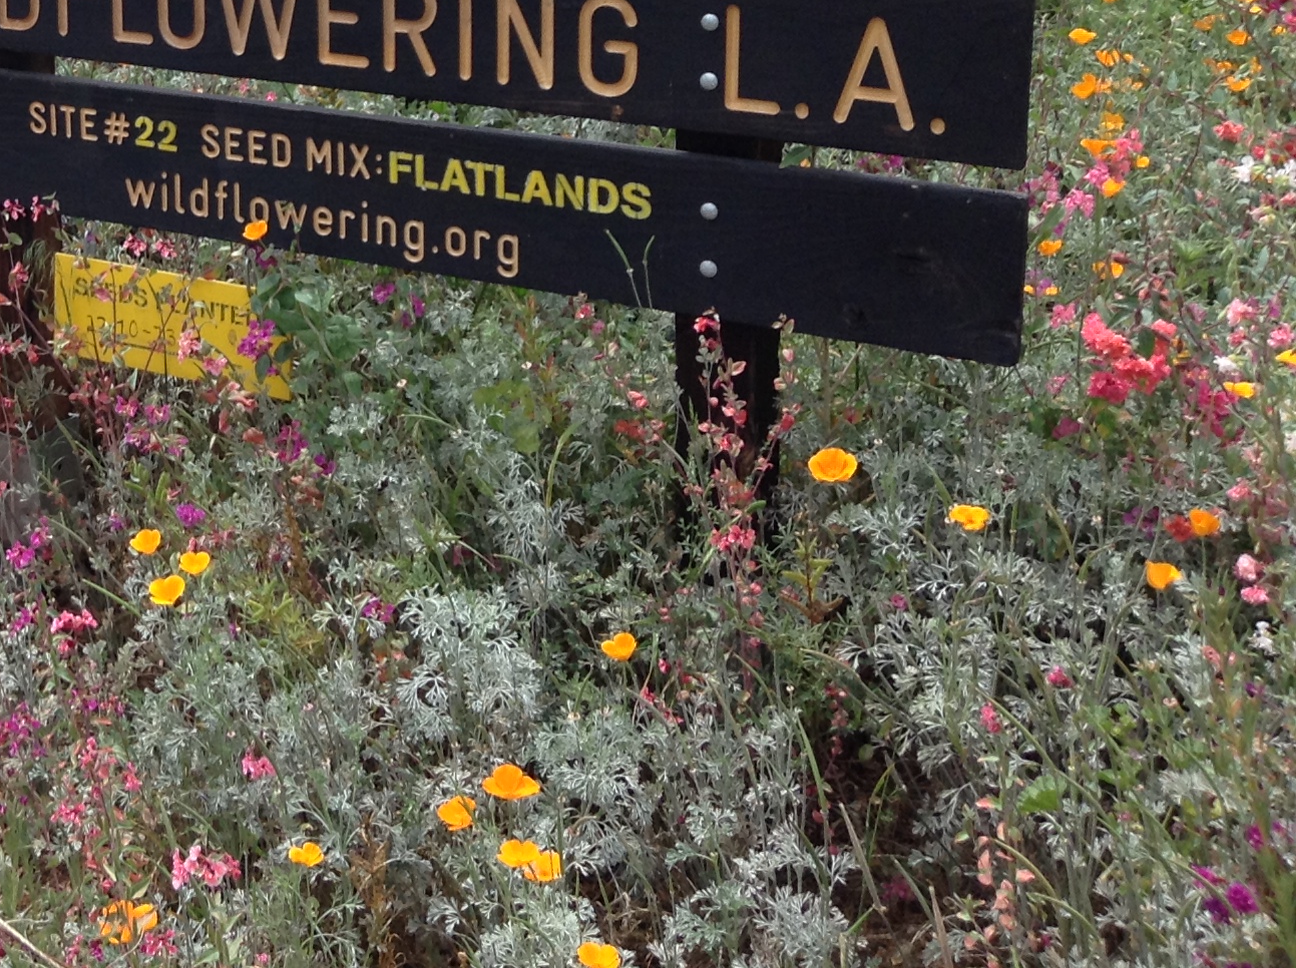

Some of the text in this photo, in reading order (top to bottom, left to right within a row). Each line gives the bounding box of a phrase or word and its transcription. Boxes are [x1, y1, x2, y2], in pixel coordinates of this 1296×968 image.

[723, 4, 947, 135] L.A.
[200, 123, 292, 168] SEED
[124, 171, 520, 278] wildflowering.org
